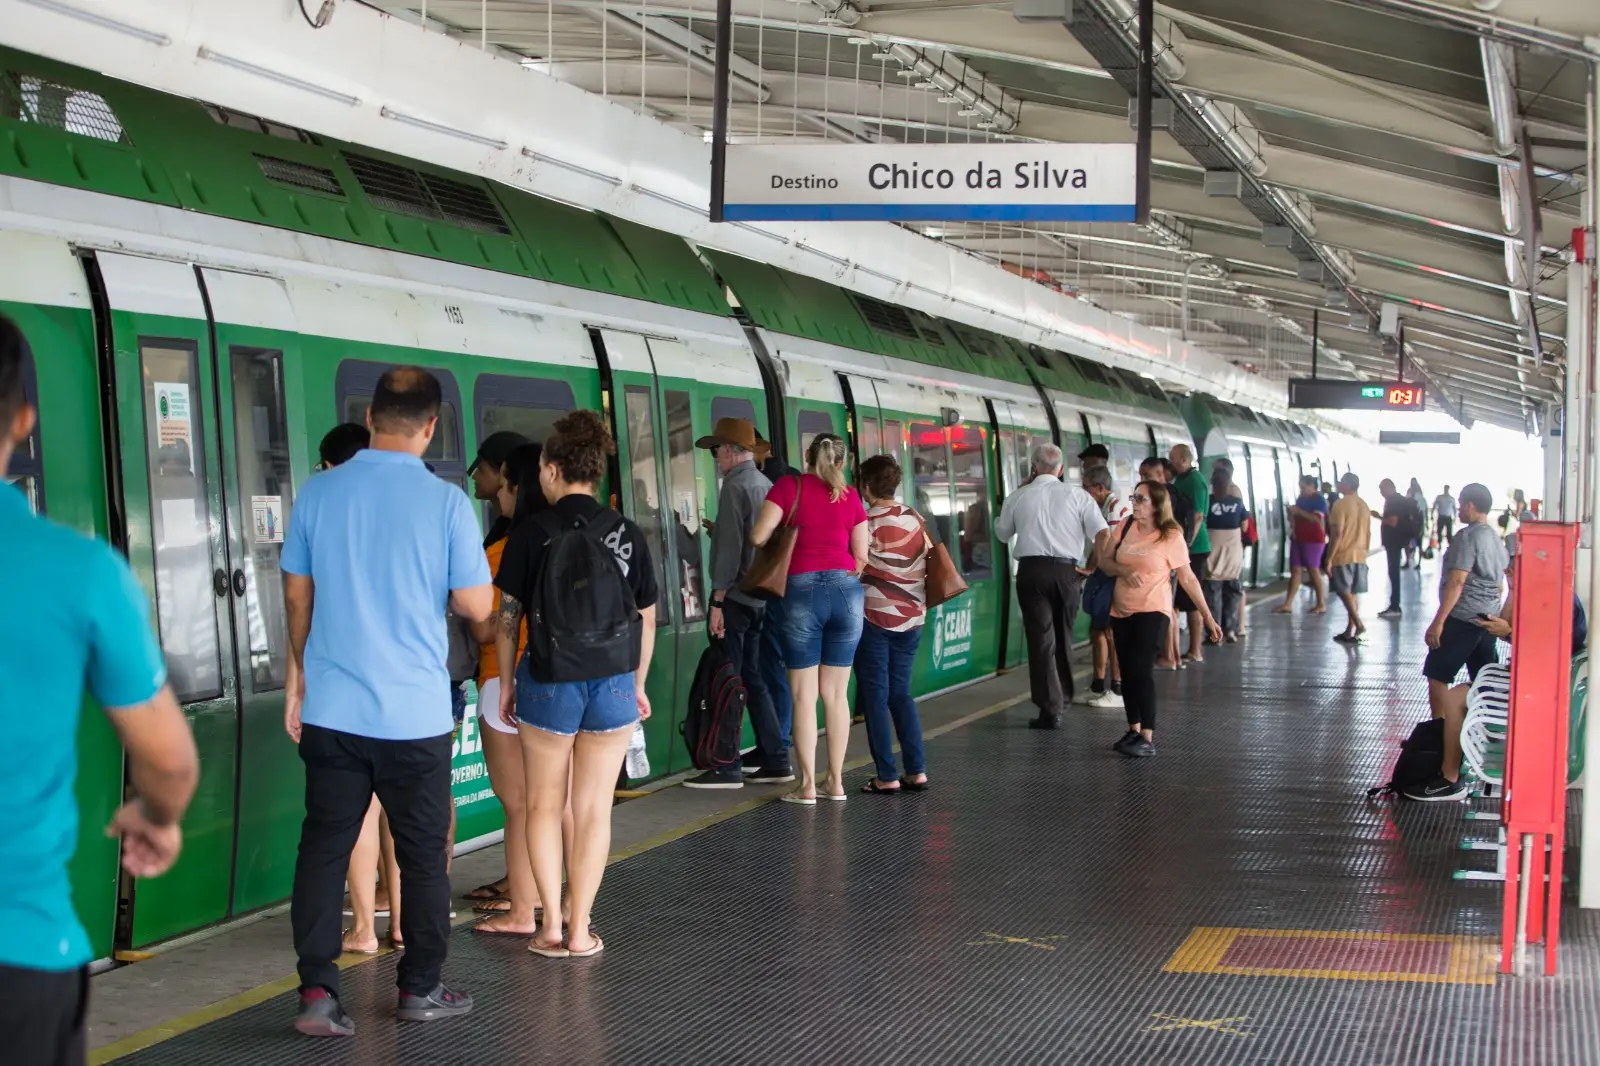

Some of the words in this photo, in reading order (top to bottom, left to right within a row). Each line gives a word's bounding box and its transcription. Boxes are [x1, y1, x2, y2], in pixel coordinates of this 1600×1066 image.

[771, 174, 838, 189] Destino
[868, 162, 954, 190] Chico
[966, 161, 1001, 189] da
[1015, 161, 1087, 189] Silva
[444, 304, 464, 325] 1153
[1389, 389, 1422, 405] 10:31
[945, 598, 971, 642] CEARÁ
